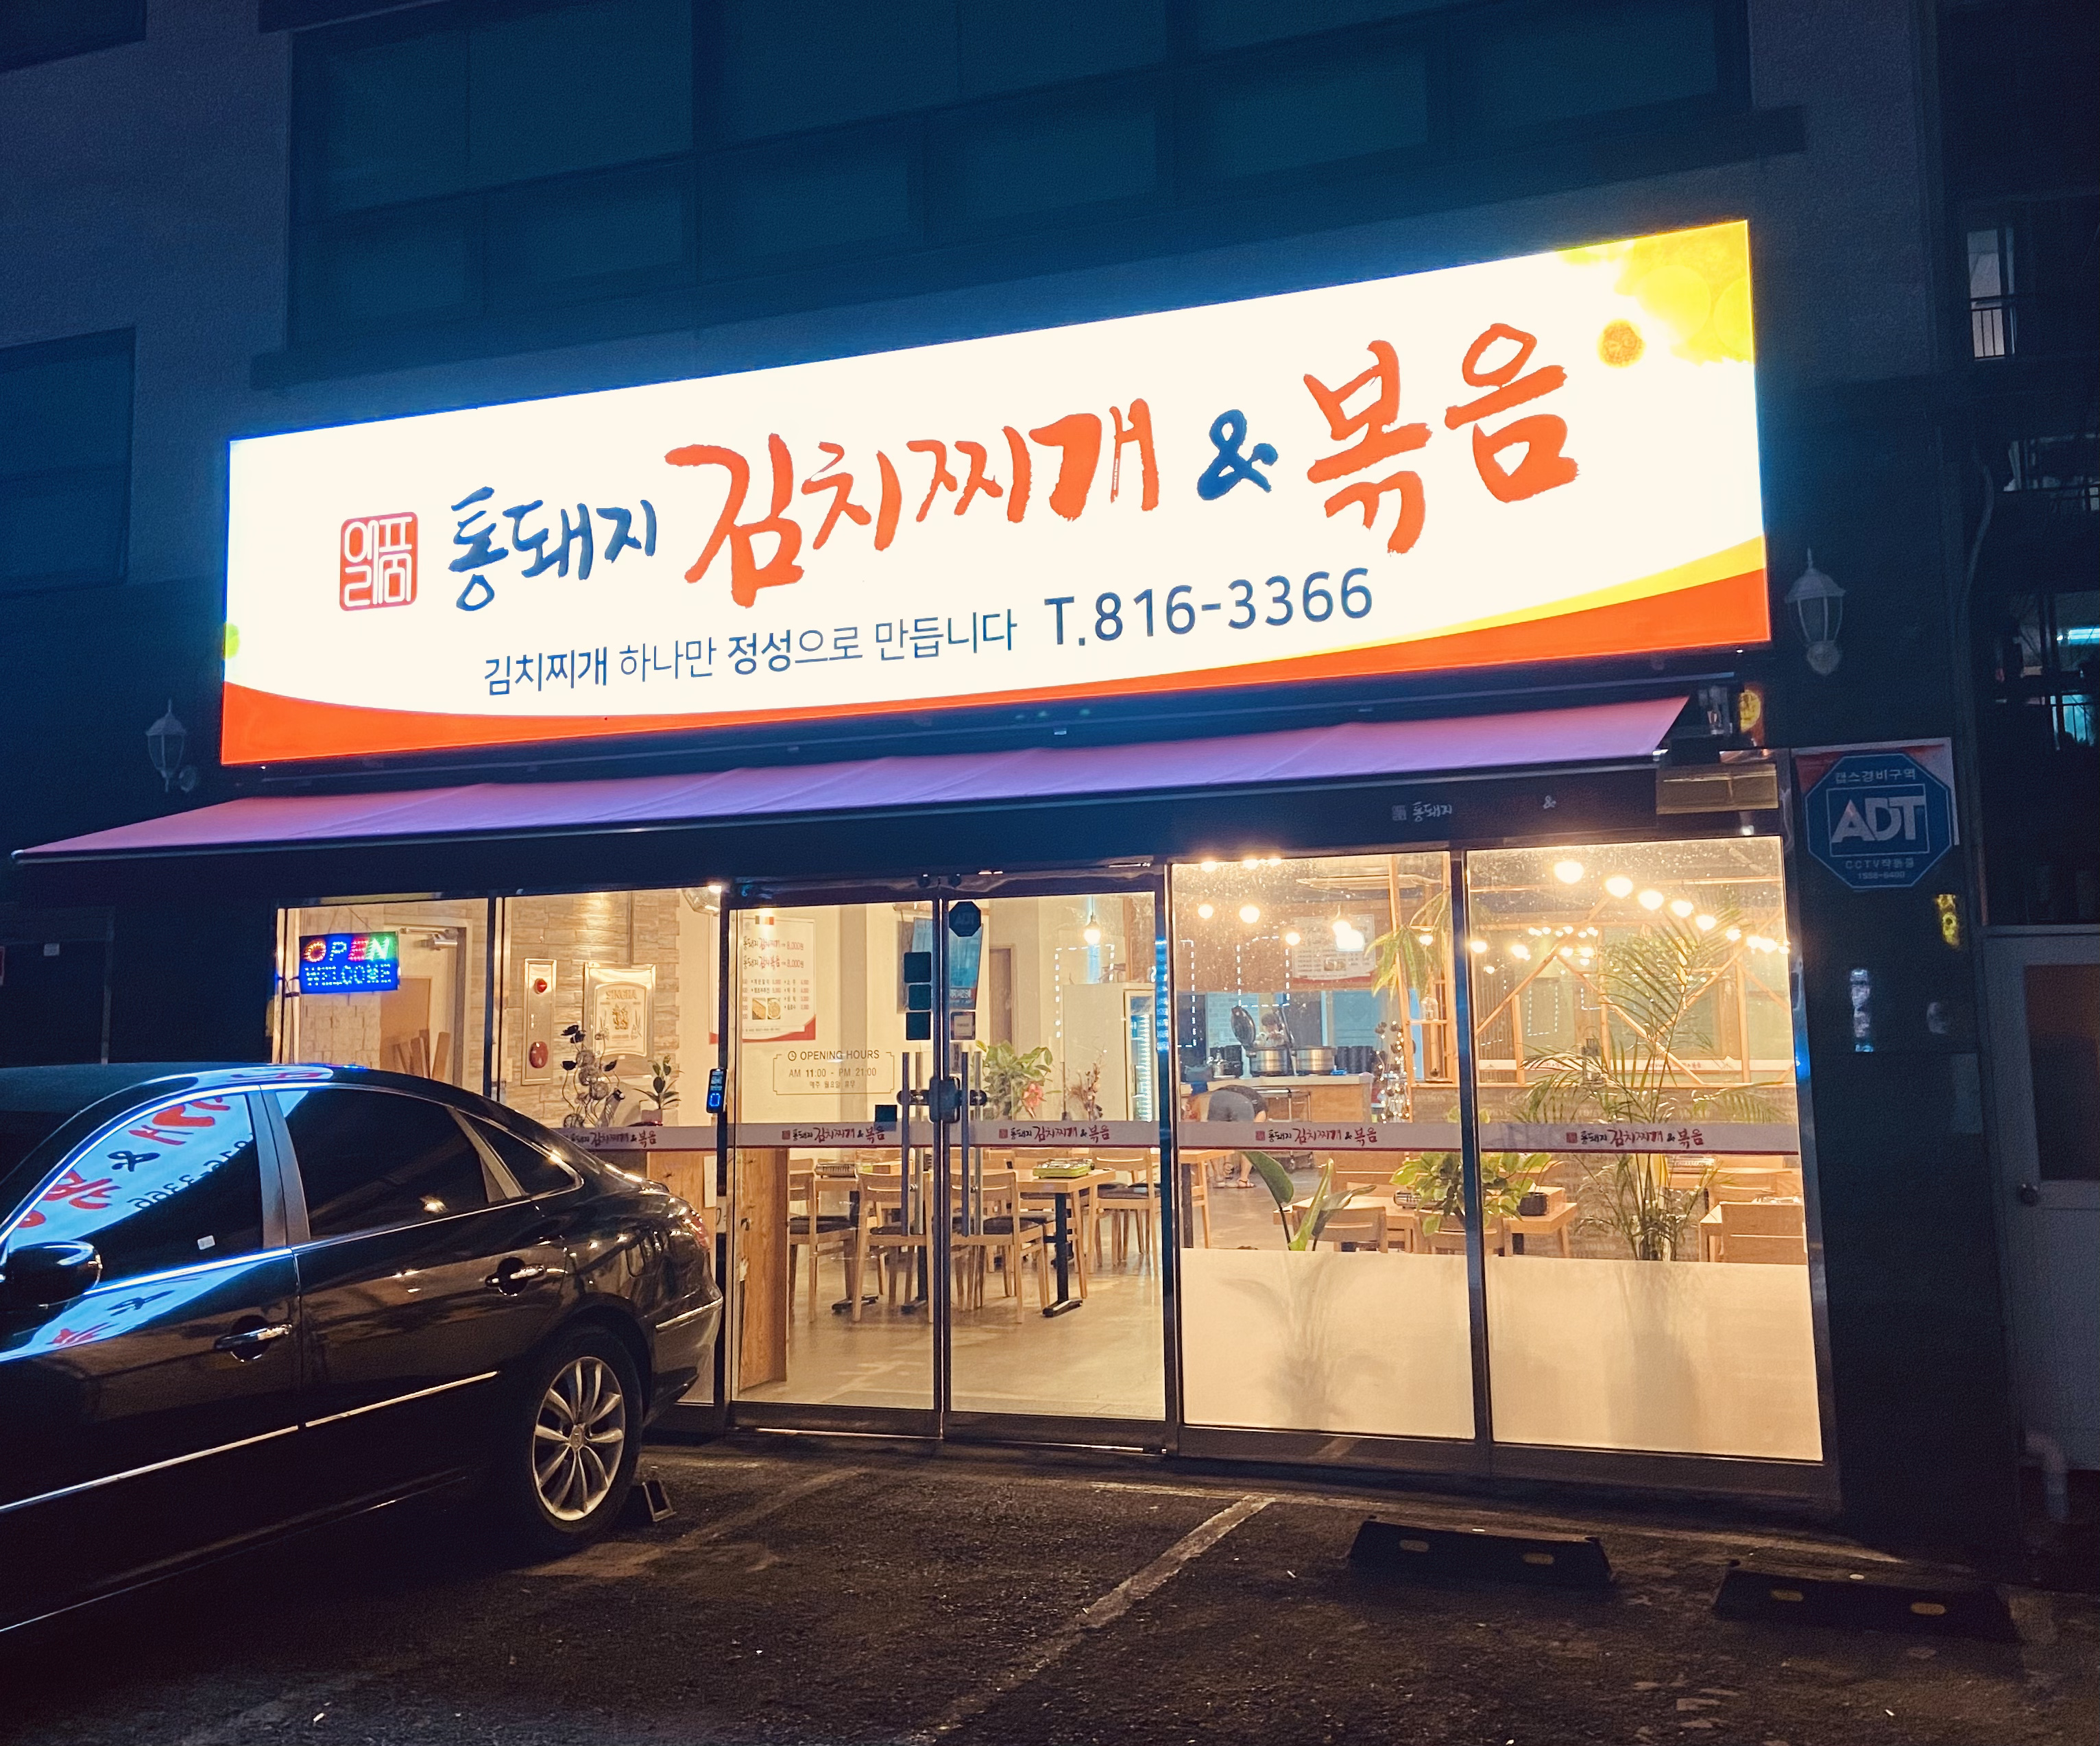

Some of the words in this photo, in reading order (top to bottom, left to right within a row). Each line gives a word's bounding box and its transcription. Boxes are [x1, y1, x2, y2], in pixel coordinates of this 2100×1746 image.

[448, 486, 657, 612] 통돼지
[664, 398, 1160, 609] 김치찌개
[1196, 409, 1279, 501] &
[1303, 322, 1580, 555] 볶음
[339, 512, 419, 612] 일품
[1043, 567, 1373, 647] T.816-3366
[484, 646, 607, 696] 김치찌개
[618, 636, 717, 682] 하나만
[727, 626, 863, 675] 정성으로
[876, 608, 1018, 661] 만듭니다
[1412, 801, 1452, 822] 통돼지
[1831, 796, 1926, 843] ADT
[304, 937, 391, 963] OPEN
[304, 964, 391, 986] WELCOME
[800, 1051, 843, 1060] OPENING
[846, 1049, 880, 1060] HOURS
[788, 1068, 801, 1077] AM
[806, 1068, 826, 1077] 11:00
[838, 1068, 851, 1077] PM
[855, 1067, 876, 1077] 21:00
[812, 1127, 855, 1143] 김치찌개
[865, 1126, 886, 1144] 볶음
[1032, 1125, 1078, 1143] 김치찌개
[1089, 1124, 1110, 1144] 볶음
[1268, 1129, 1292, 1143] 통돼지
[1292, 1127, 1342, 1146] 김치찌개
[1354, 1127, 1377, 1147] 볶음
[1580, 1130, 1607, 1145] 통돼지
[1607, 1129, 1663, 1147] 김치찌개
[1678, 1128, 1704, 1149] 볶음
